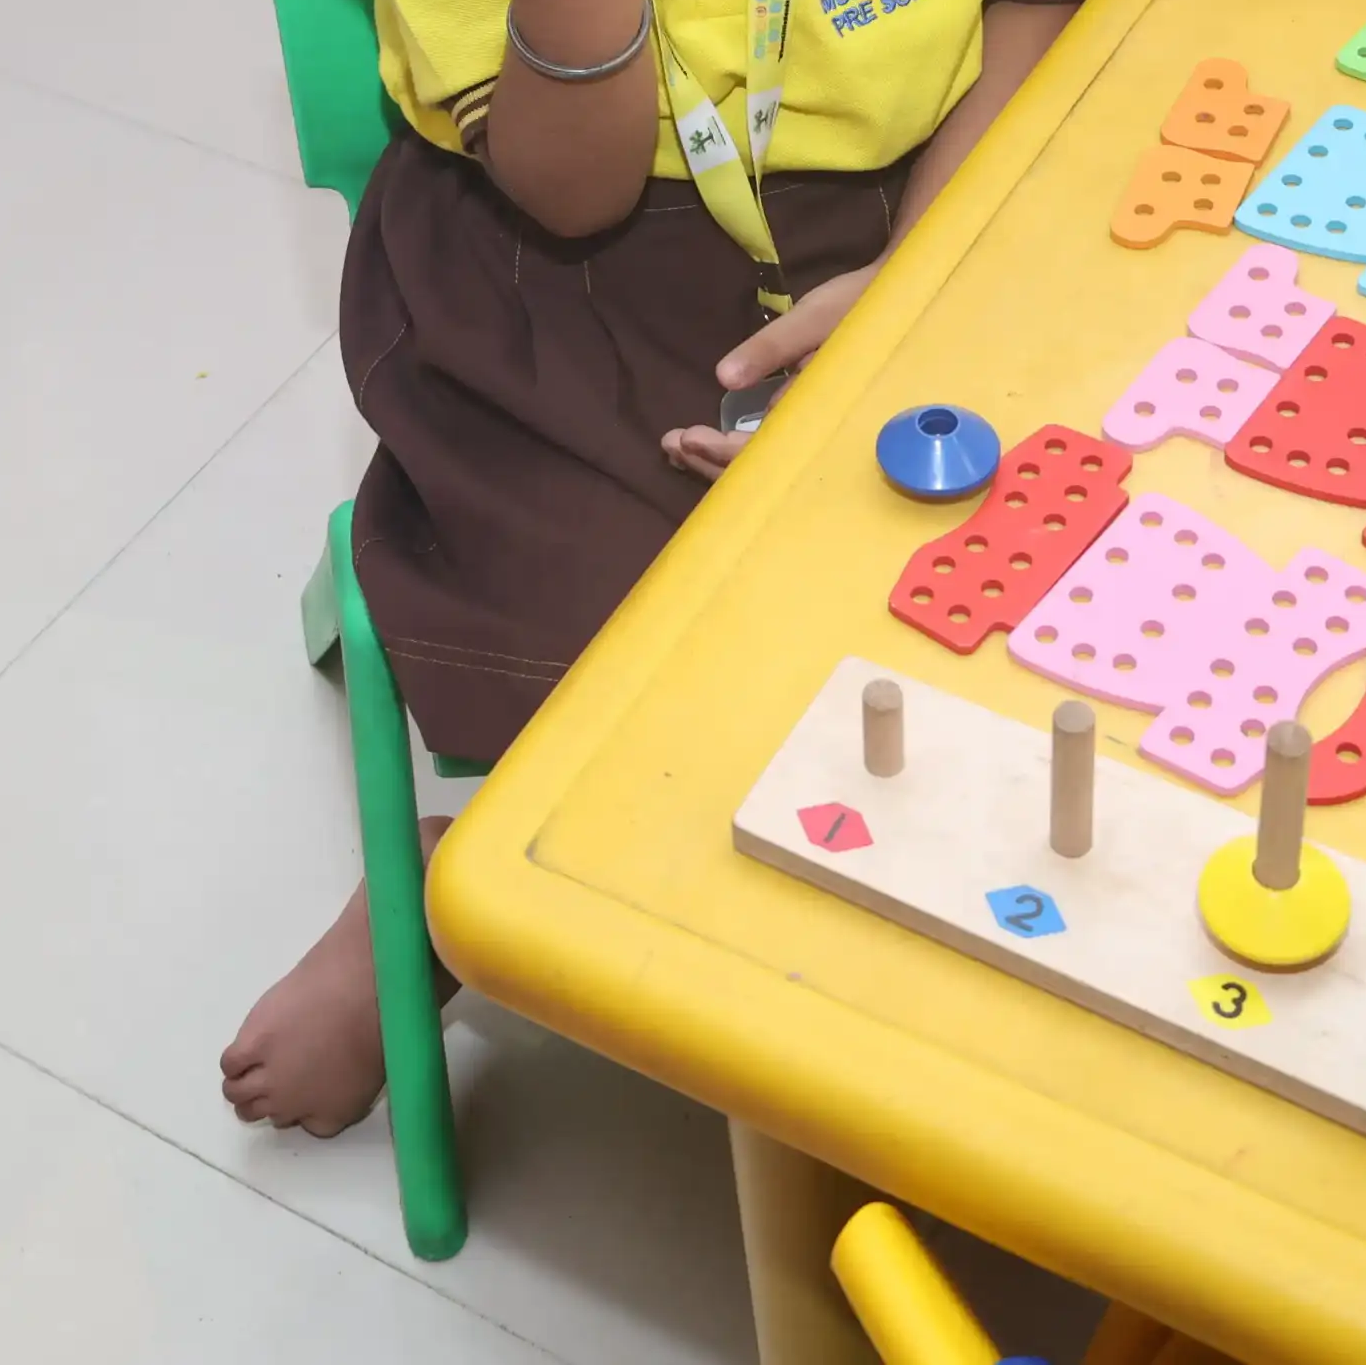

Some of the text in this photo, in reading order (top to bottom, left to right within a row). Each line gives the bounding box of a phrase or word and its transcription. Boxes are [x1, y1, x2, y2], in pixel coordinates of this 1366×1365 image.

[831, 0, 878, 38] PRE
[822, 811, 848, 845] 1
[1004, 892, 1045, 933] 2
[1210, 981, 1248, 1019] 3
